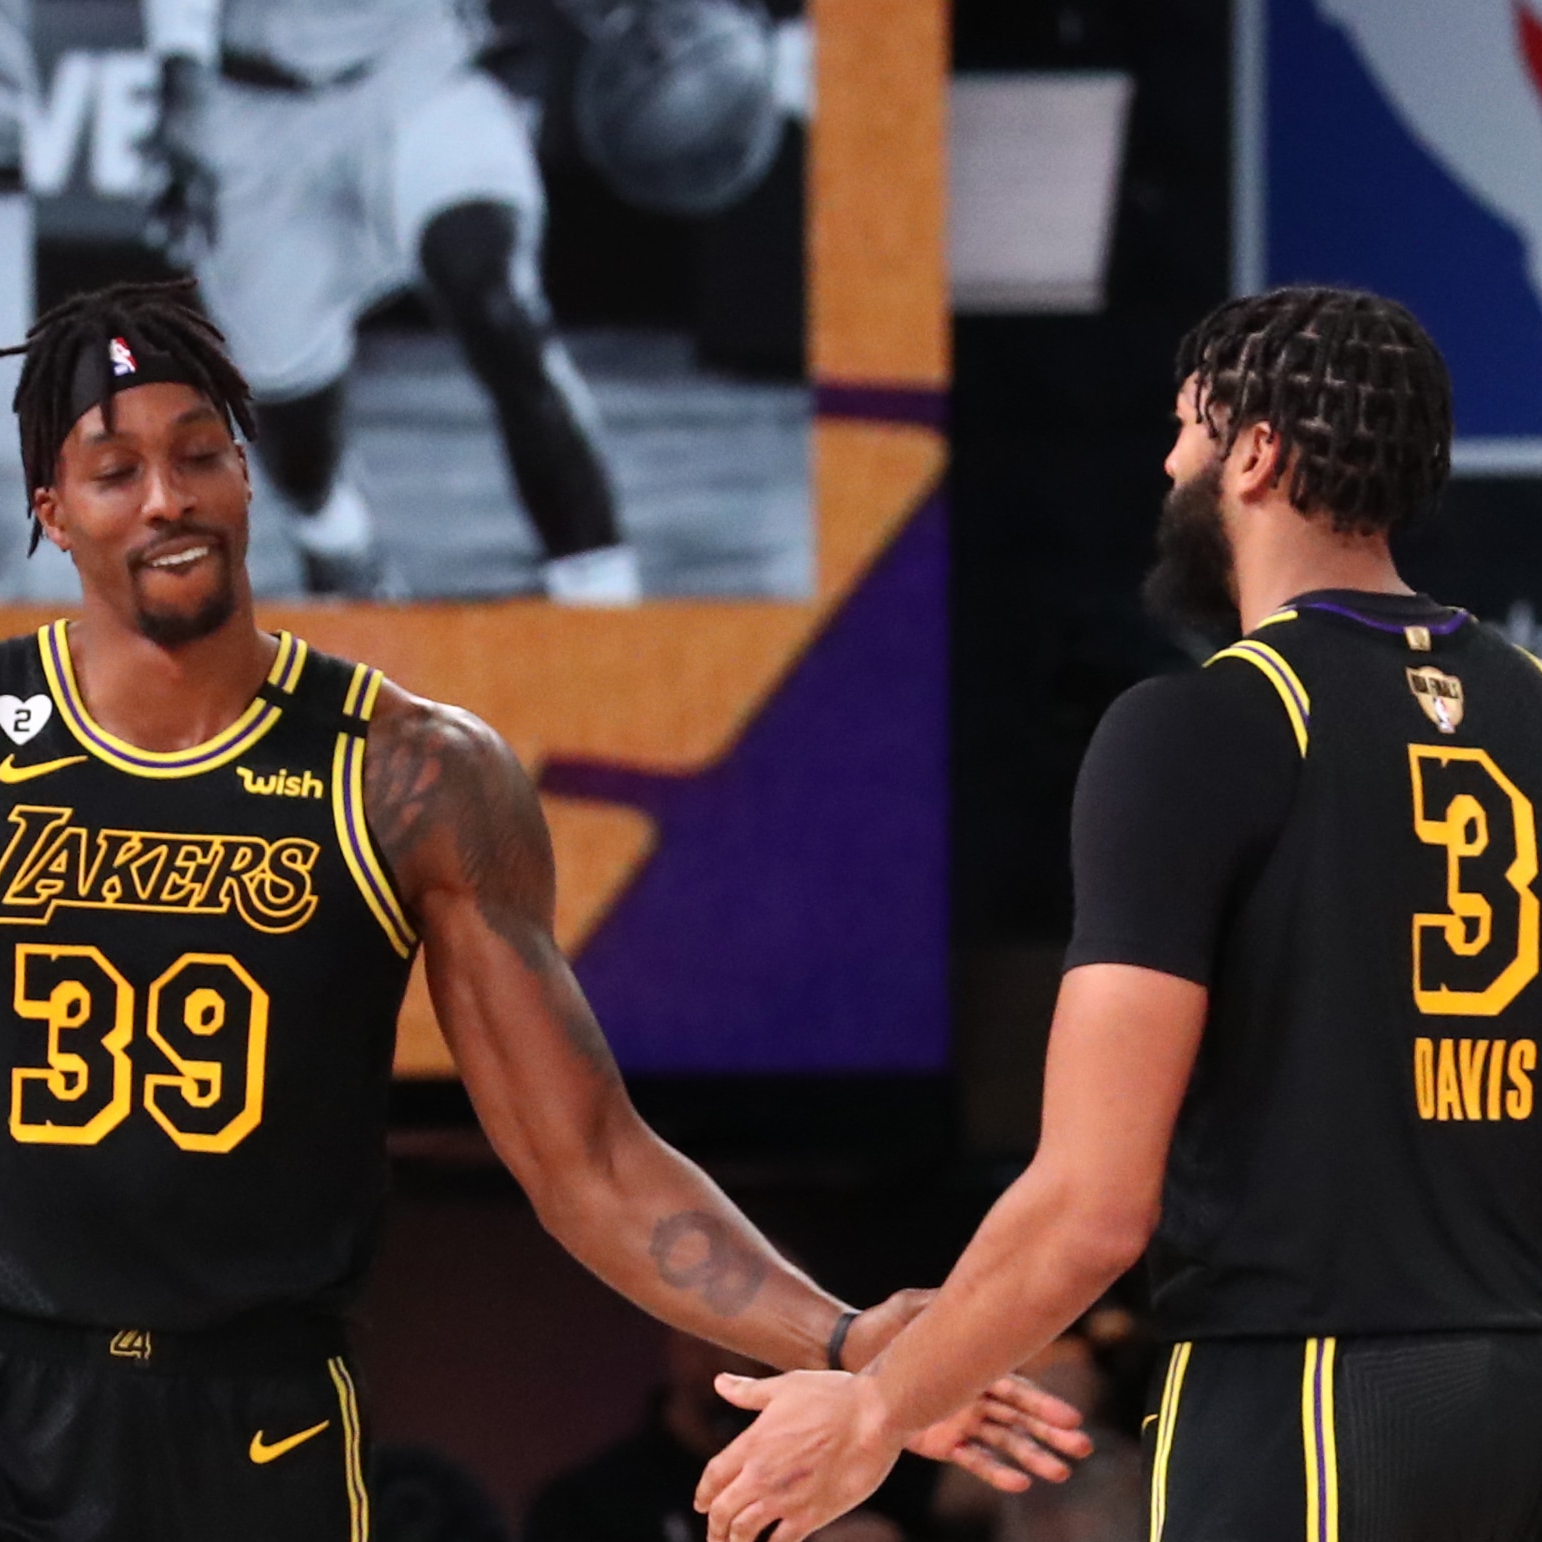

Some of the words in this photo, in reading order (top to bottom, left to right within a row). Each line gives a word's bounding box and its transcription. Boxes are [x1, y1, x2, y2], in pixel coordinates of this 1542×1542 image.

[13, 708, 32, 733] 2
[236, 766, 323, 798] wish
[1408, 743, 1540, 1016] 3
[9, 943, 270, 1154] 39
[1413, 1037, 1538, 1121] DAVIS
